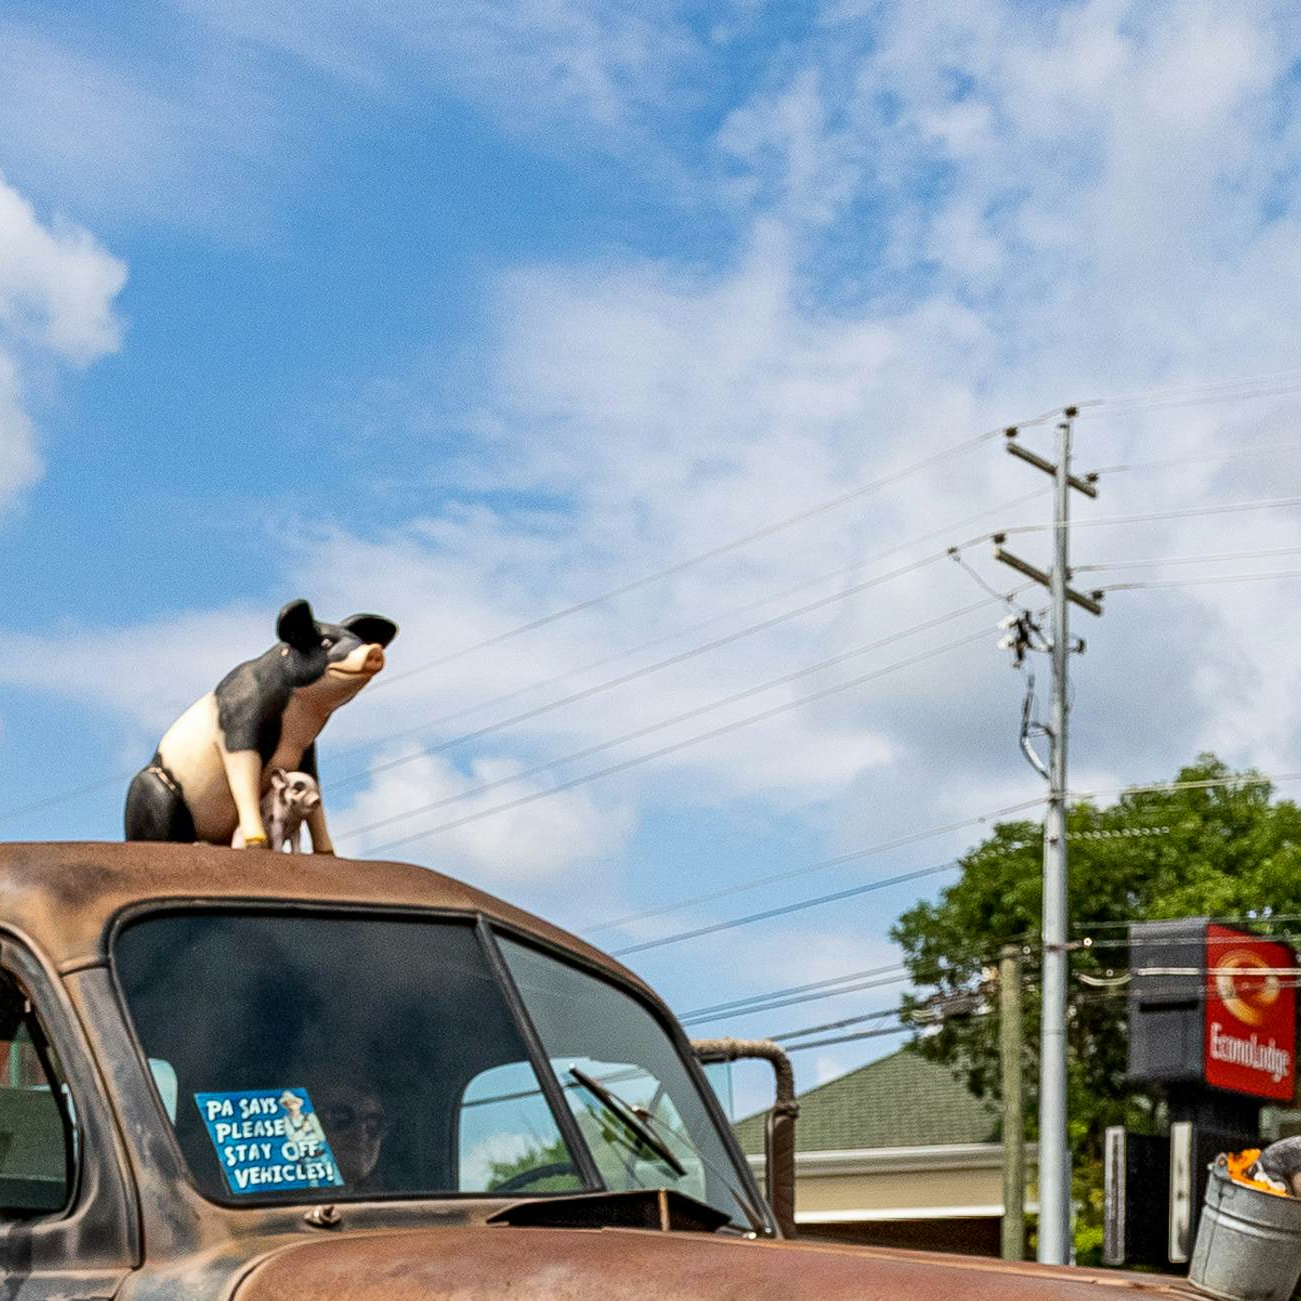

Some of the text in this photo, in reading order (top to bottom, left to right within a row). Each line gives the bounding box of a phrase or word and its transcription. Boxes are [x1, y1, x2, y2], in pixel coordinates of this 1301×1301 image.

[205, 1097, 278, 1121] PA SAYS
[215, 1119, 286, 1144] PLEASE
[224, 1140, 321, 1167] STAY OFF
[233, 1161, 335, 1189] VEHICLES!
